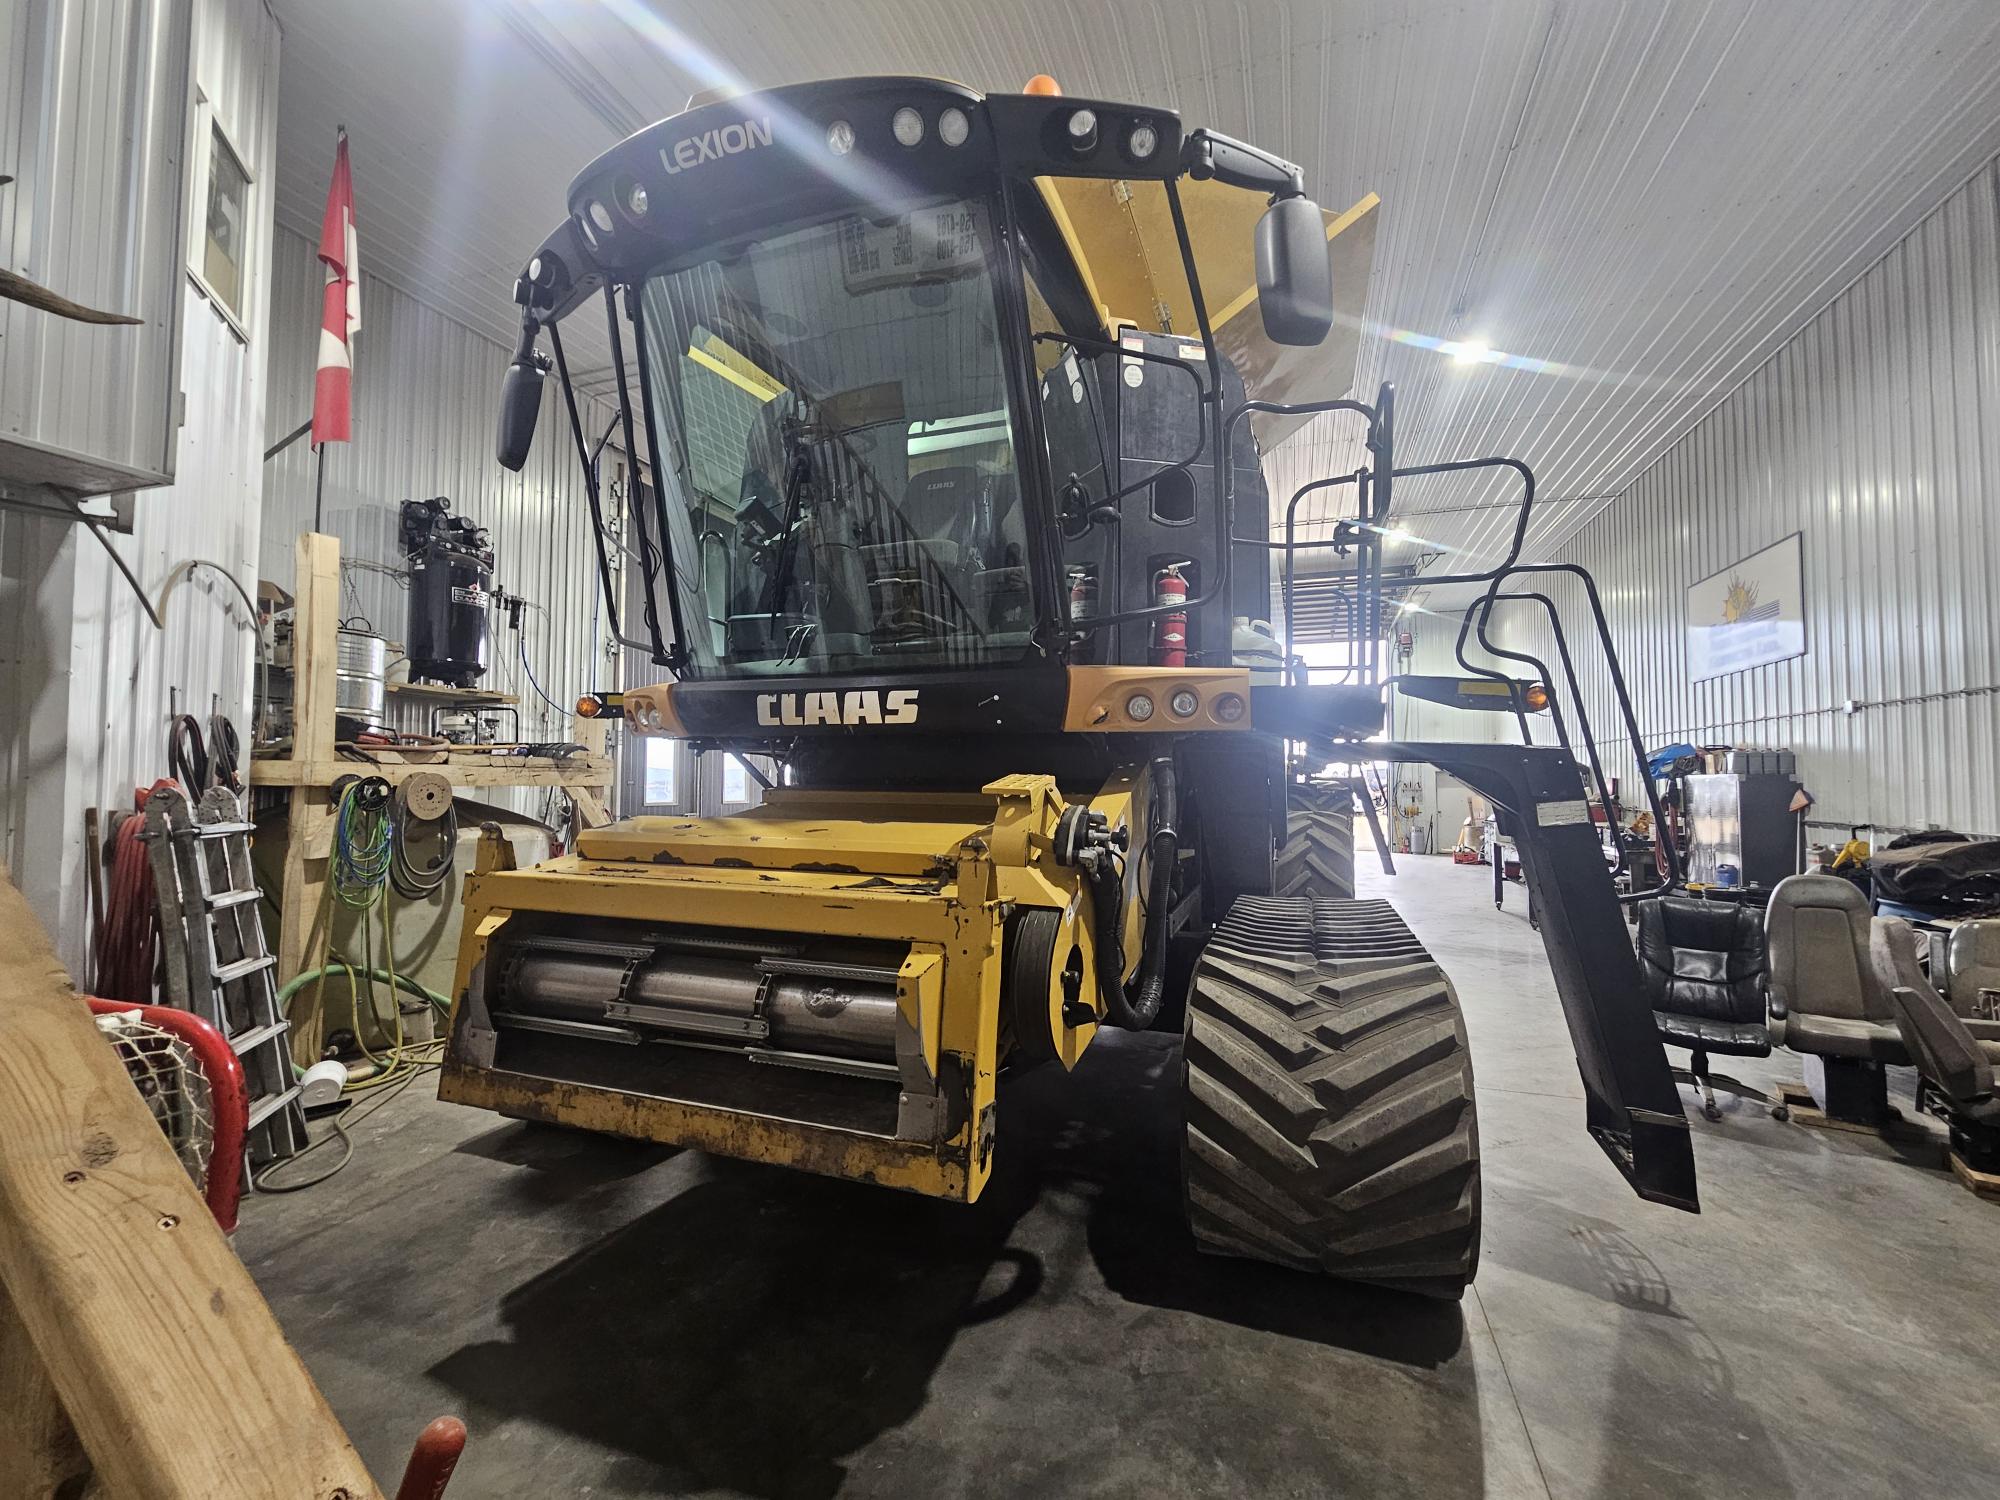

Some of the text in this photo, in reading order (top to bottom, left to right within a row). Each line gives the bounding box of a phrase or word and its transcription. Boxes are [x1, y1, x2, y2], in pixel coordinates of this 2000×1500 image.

[659, 116, 773, 175] LEXION
[927, 481, 955, 490] CLAAS
[756, 689, 920, 726] CLAAS
